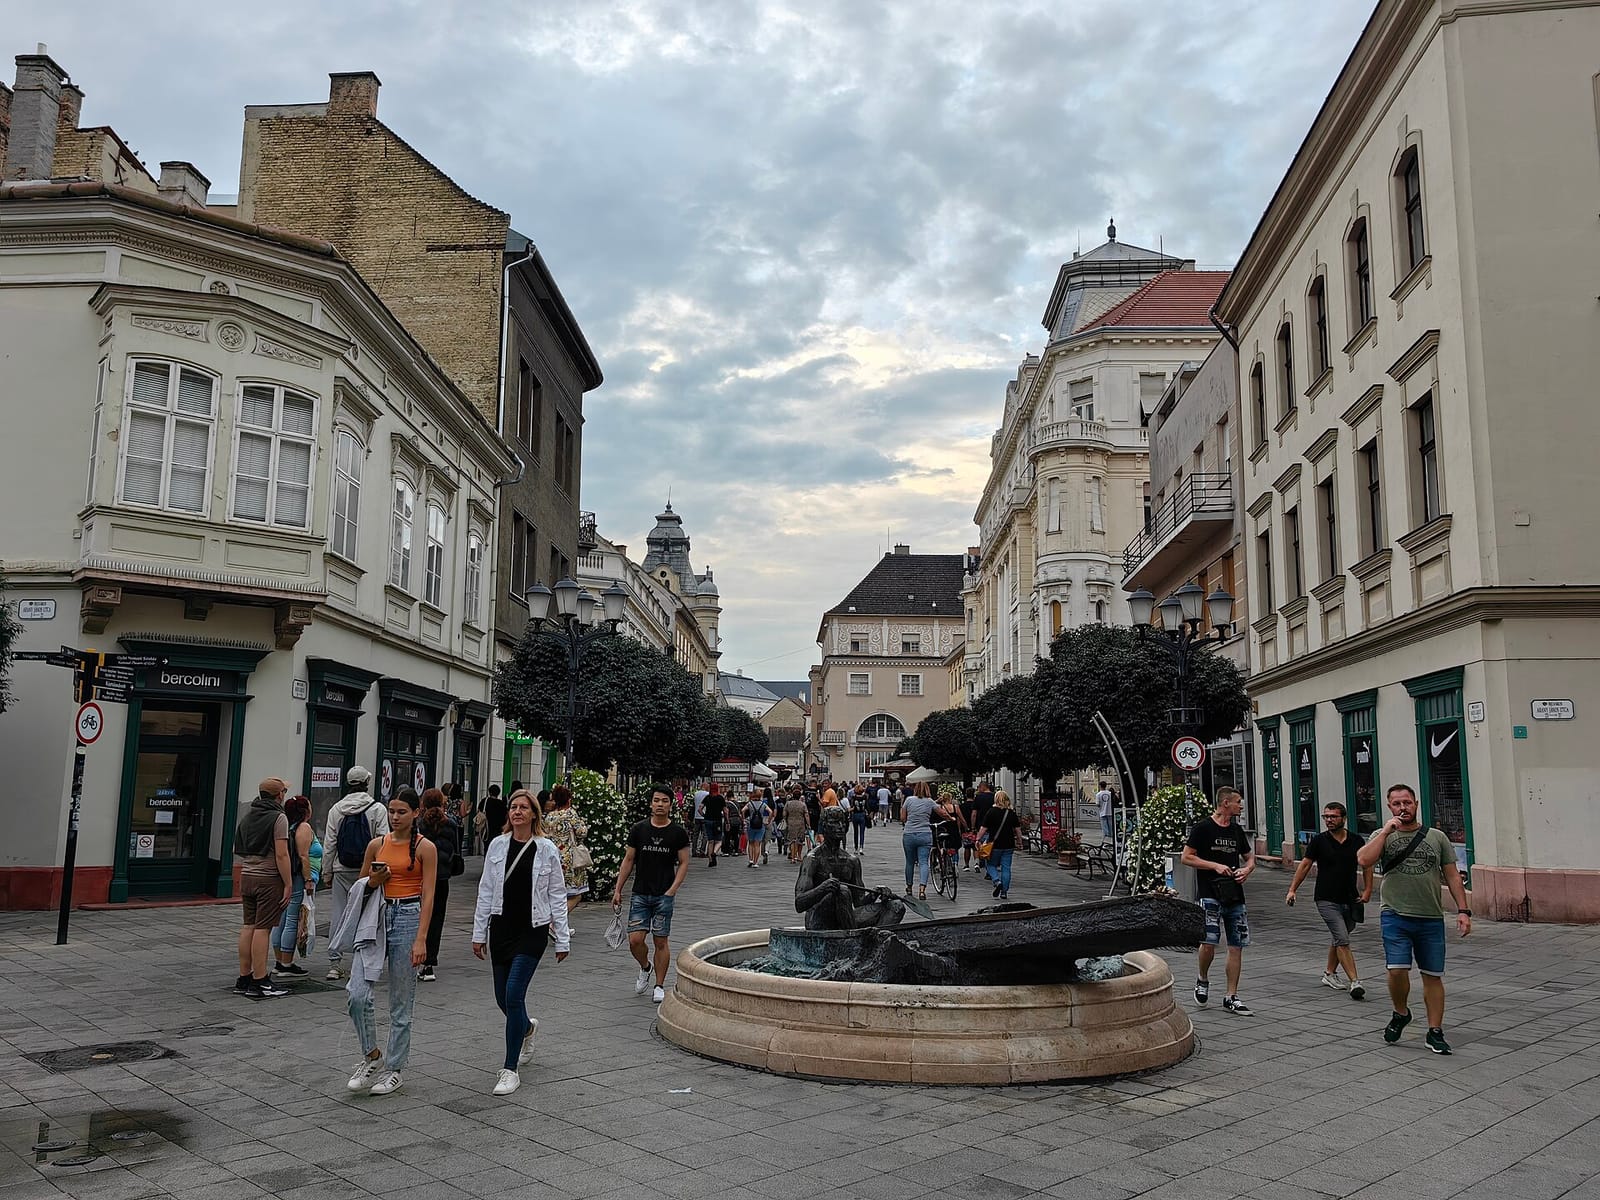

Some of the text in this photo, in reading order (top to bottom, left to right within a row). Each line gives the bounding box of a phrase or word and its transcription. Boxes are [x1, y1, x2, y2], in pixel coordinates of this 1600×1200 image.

[160, 671, 221, 689] bercolini
[149, 798, 183, 806] bercolini
[642, 844, 670, 853] ARMANI
